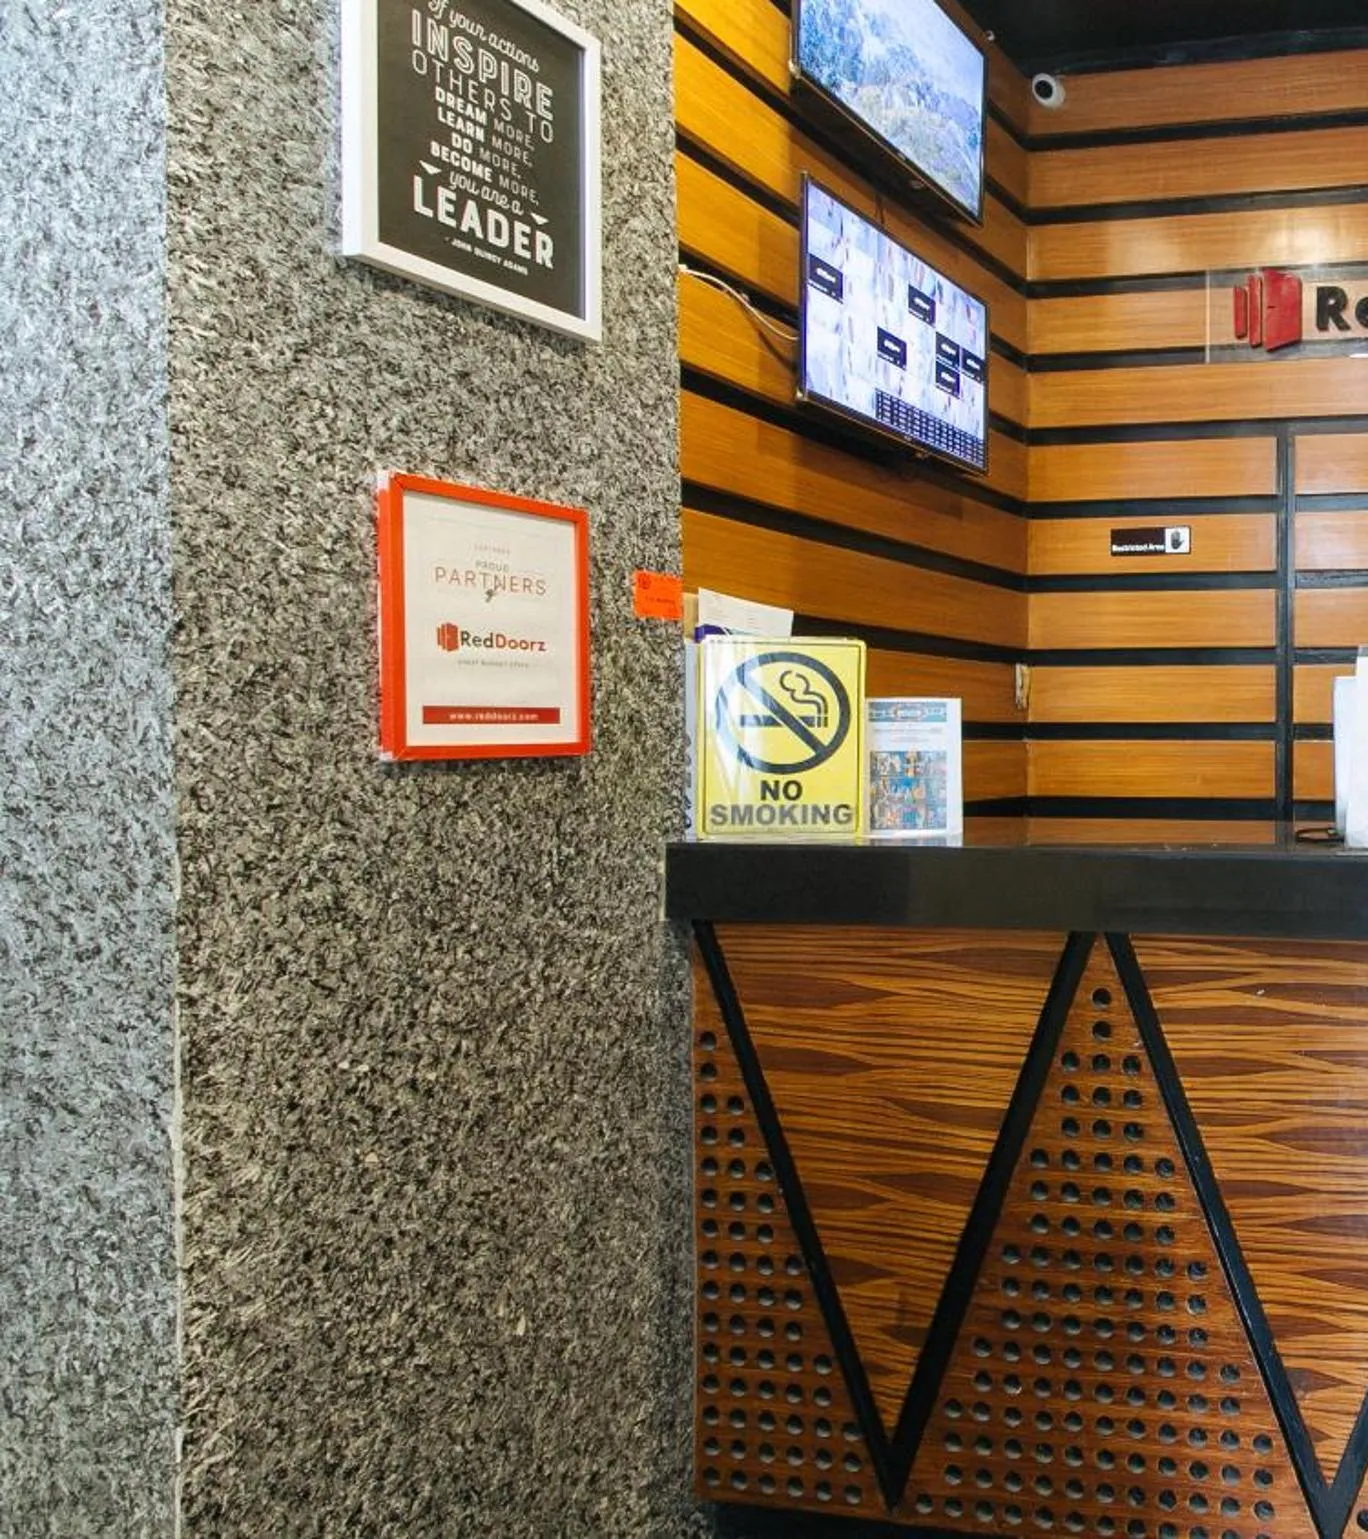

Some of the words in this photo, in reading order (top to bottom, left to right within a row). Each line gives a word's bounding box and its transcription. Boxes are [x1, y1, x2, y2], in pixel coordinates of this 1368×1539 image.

[449, 10, 488, 41] your
[488, 33, 540, 73] actions
[412, 9, 554, 121] INSPIRE
[412, 49, 512, 121] OTHERS
[525, 110, 554, 144] TO
[435, 85, 488, 126] DREAM
[438, 106, 485, 143] LEARN
[451, 132, 473, 154] DO
[430, 140, 493, 183] BECOME
[449, 171, 480, 196] you
[481, 185, 511, 209] are
[511, 200, 524, 216] a
[413, 175, 554, 269] LEADER
[435, 566, 547, 596] PARTNERS
[460, 630, 547, 652] RedDoorz
[760, 780, 803, 801] NO
[710, 804, 853, 826] SMOKING
